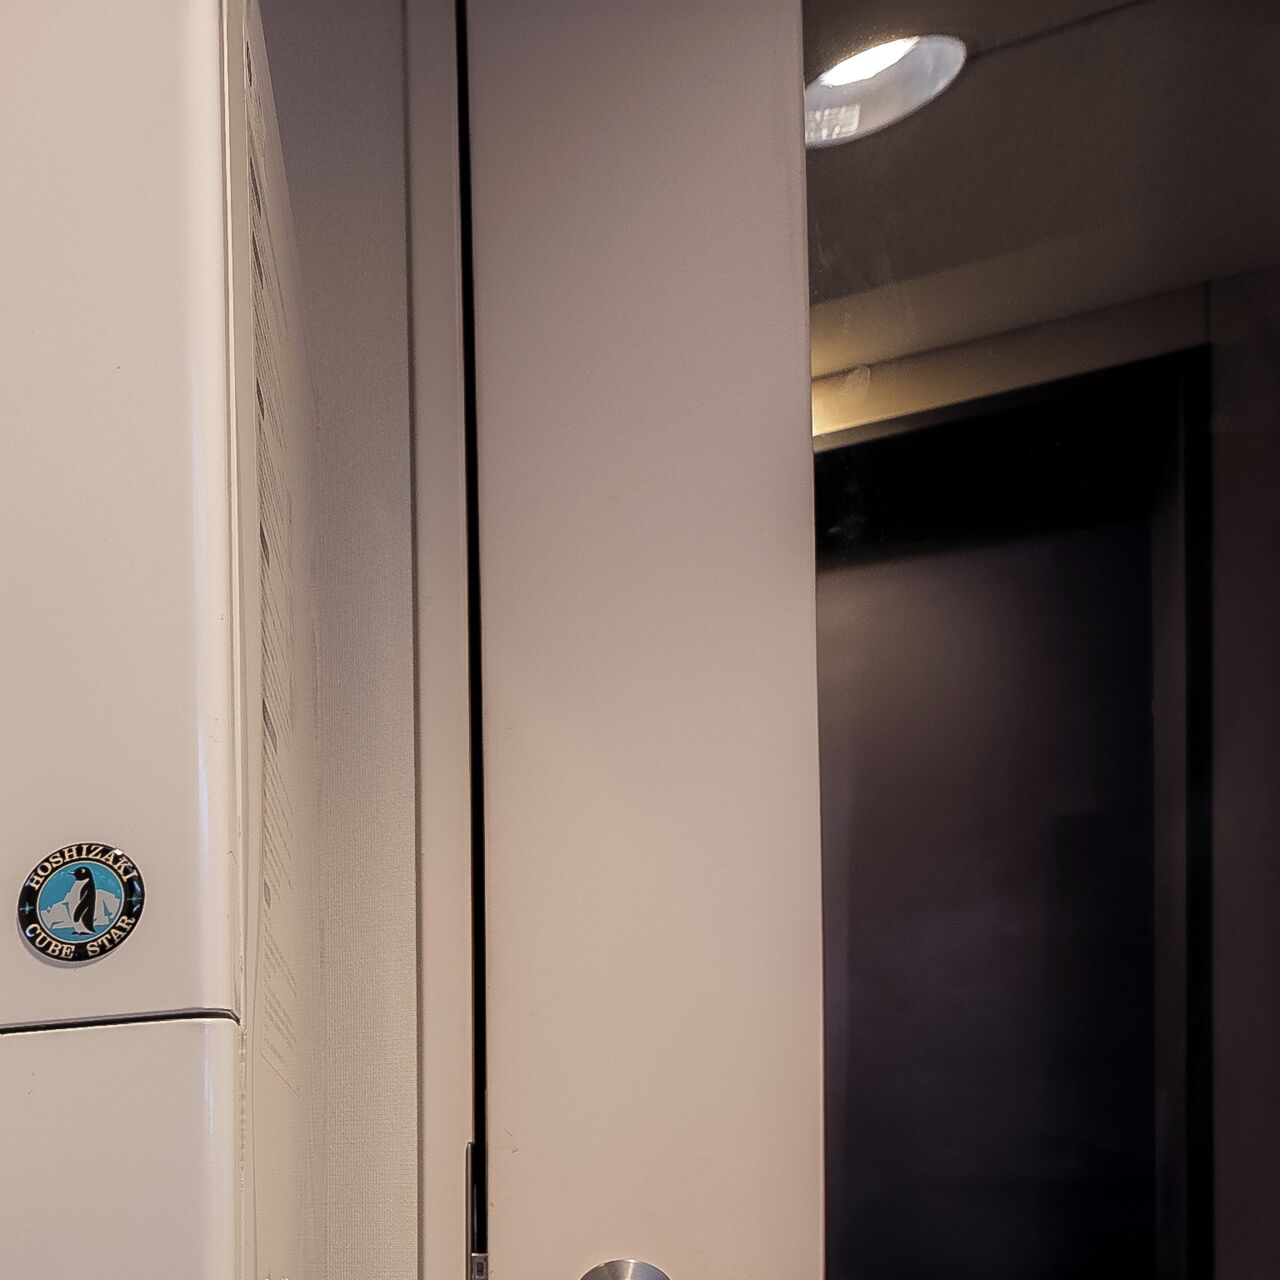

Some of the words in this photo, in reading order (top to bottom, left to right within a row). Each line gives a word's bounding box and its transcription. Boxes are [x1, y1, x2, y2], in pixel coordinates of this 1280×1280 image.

[25, 844, 139, 891] HOSHIZAKI
[25, 923, 76, 959] CUBE
[86, 915, 136, 957] STAR
